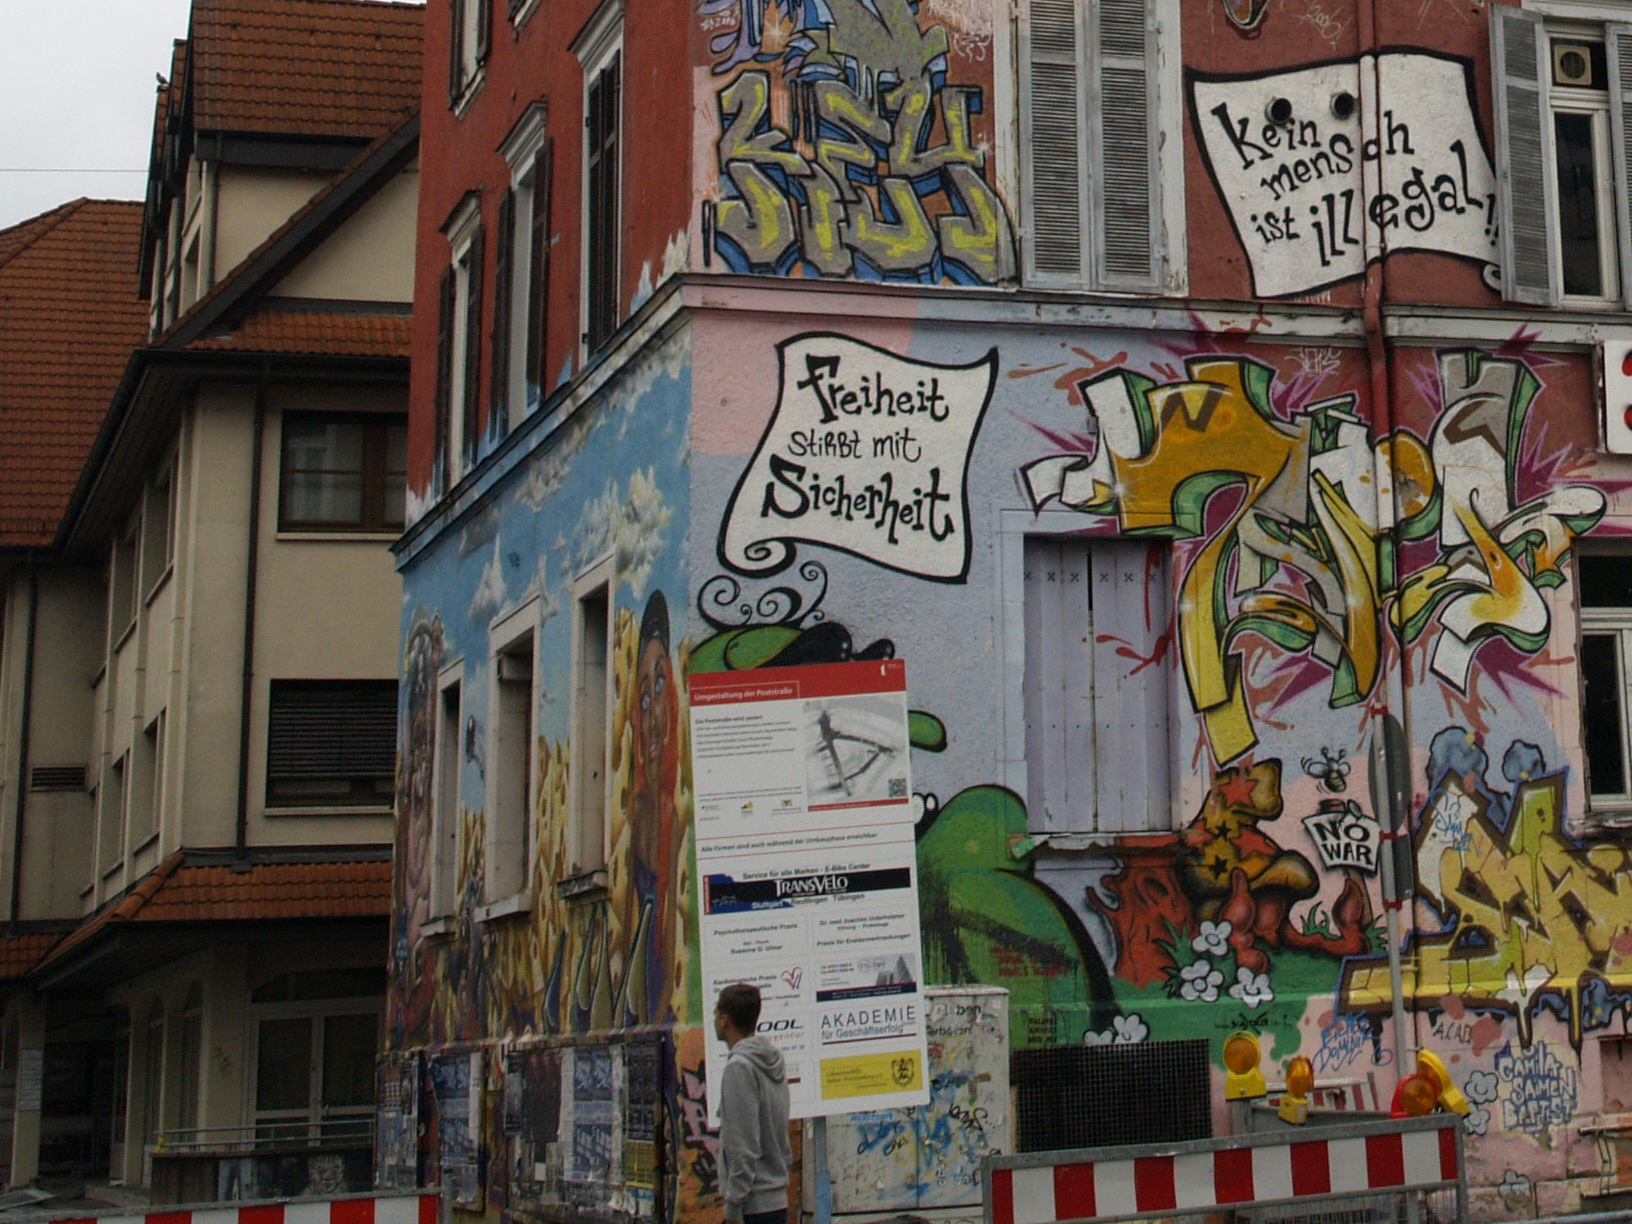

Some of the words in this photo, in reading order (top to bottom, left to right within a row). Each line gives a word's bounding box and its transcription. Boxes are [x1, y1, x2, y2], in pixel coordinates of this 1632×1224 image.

[1259, 109, 1415, 201] mensch
[1249, 205, 1301, 245] ist
[796, 354, 950, 424] Freiheit
[872, 427, 923, 463] mit
[760, 452, 955, 545] Sicherheit
[1312, 820, 1371, 843] NO
[1320, 841, 1374, 866] WAR
[757, 1018, 804, 1033] OOL
[820, 1004, 917, 1030] AKADEMIE
[821, 1029, 834, 1040] für
[835, 1025, 904, 1039] Geschäftserfolg
